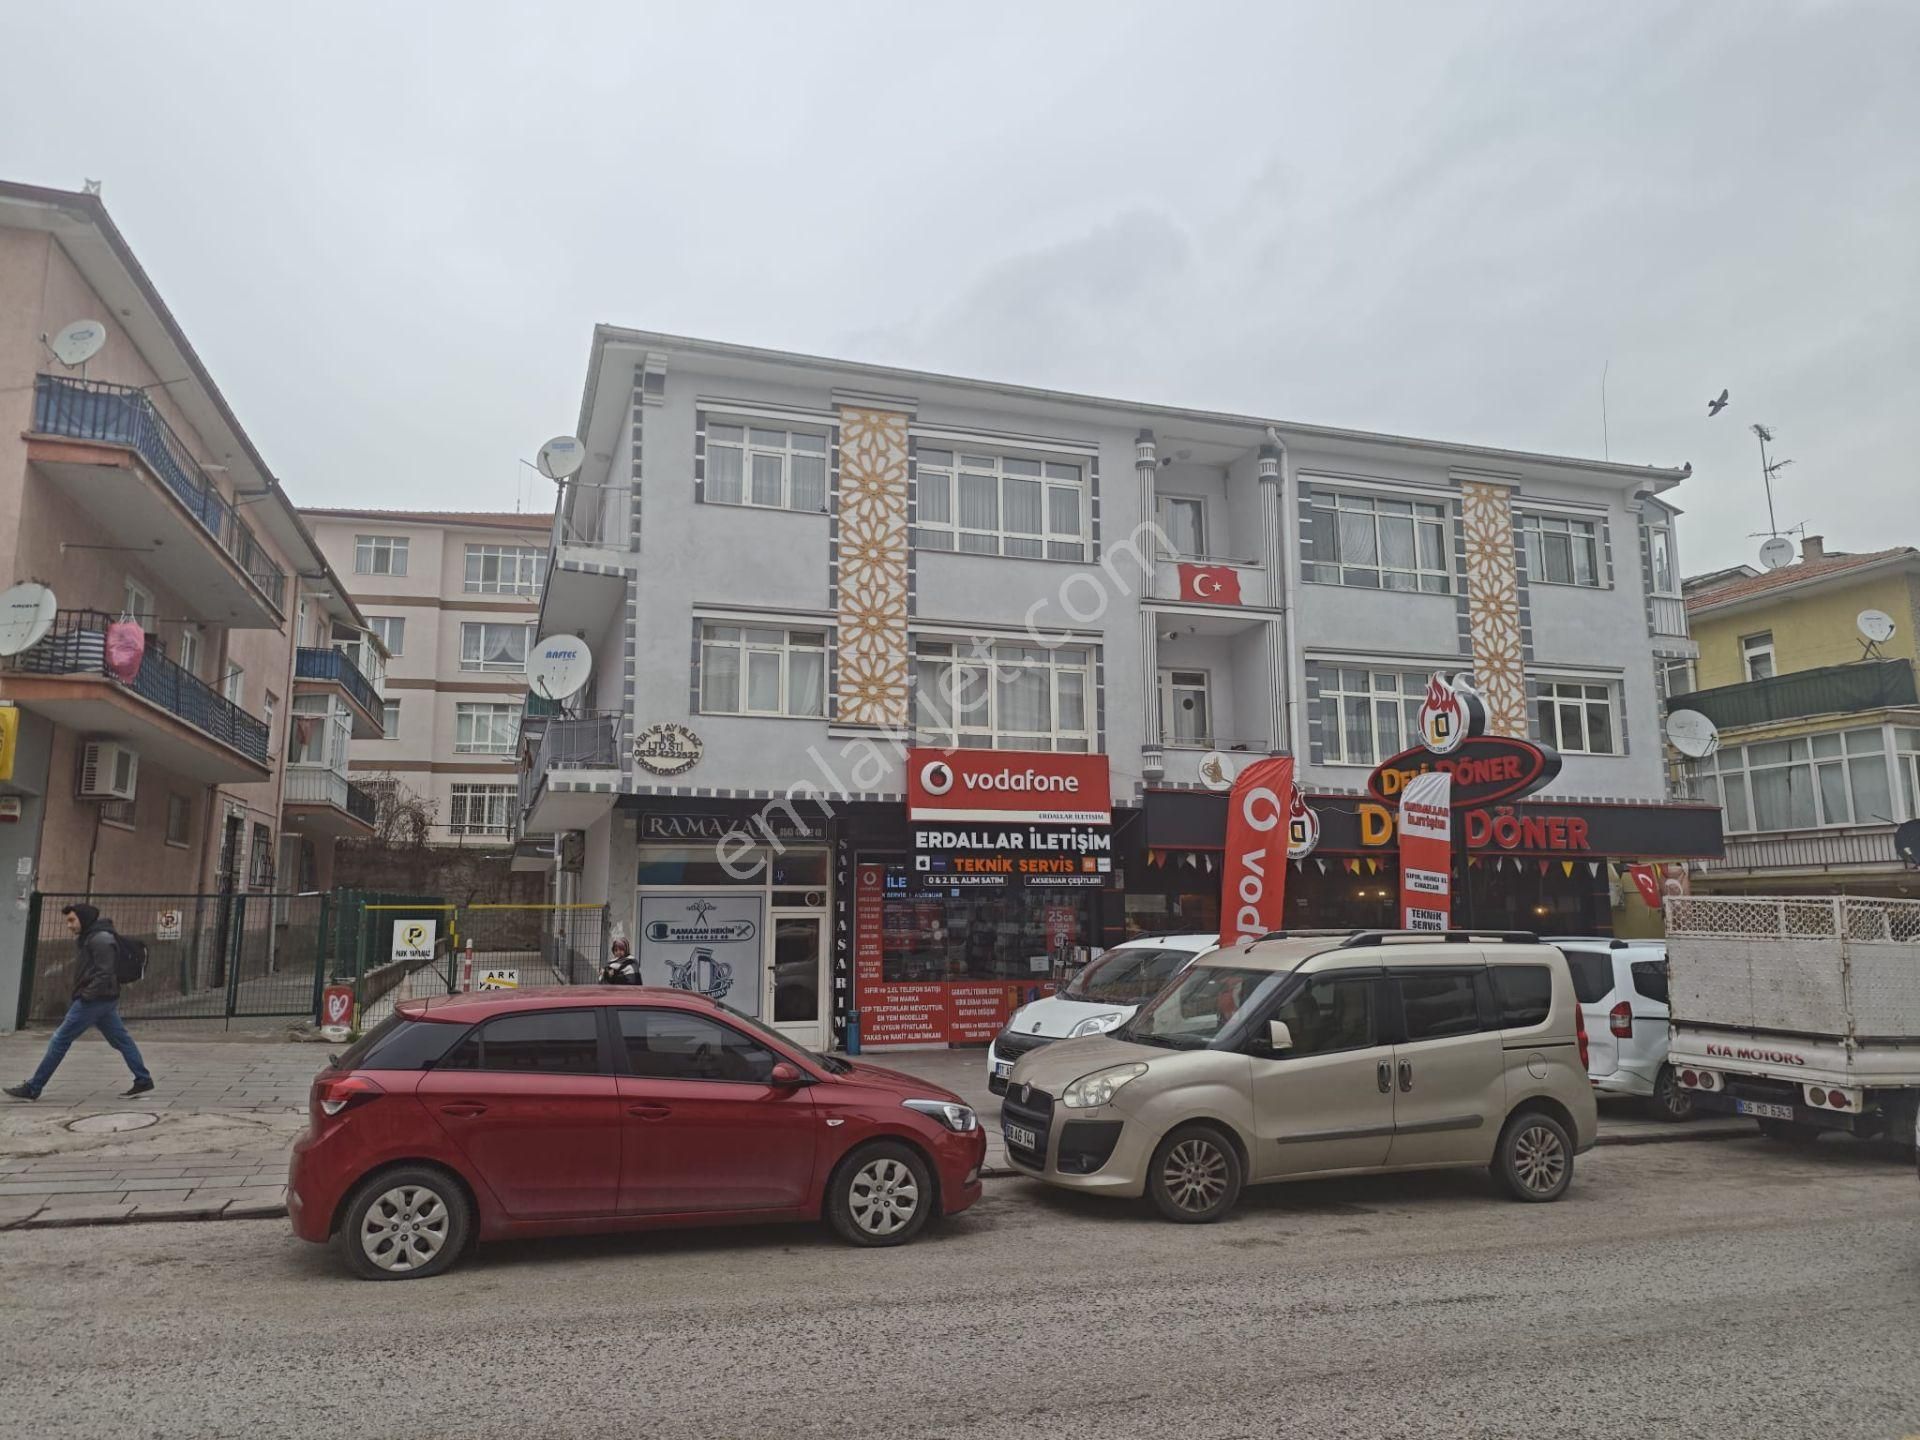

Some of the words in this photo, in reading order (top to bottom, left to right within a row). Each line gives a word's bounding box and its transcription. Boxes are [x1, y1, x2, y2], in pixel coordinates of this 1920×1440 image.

[962, 768, 1079, 792] vodafone
[1435, 755, 1523, 786] DÖNER
[1464, 806, 1590, 849] DÖNER
[915, 831, 1024, 850] ERDALLAR
[1029, 827, 1111, 855] İLETİŞİM
[954, 855, 1014, 872] TEKNİK
[1019, 855, 1074, 872] SERVİS
[1706, 1043, 1733, 1057] KIA
[1737, 1047, 1805, 1066] MOTORS
